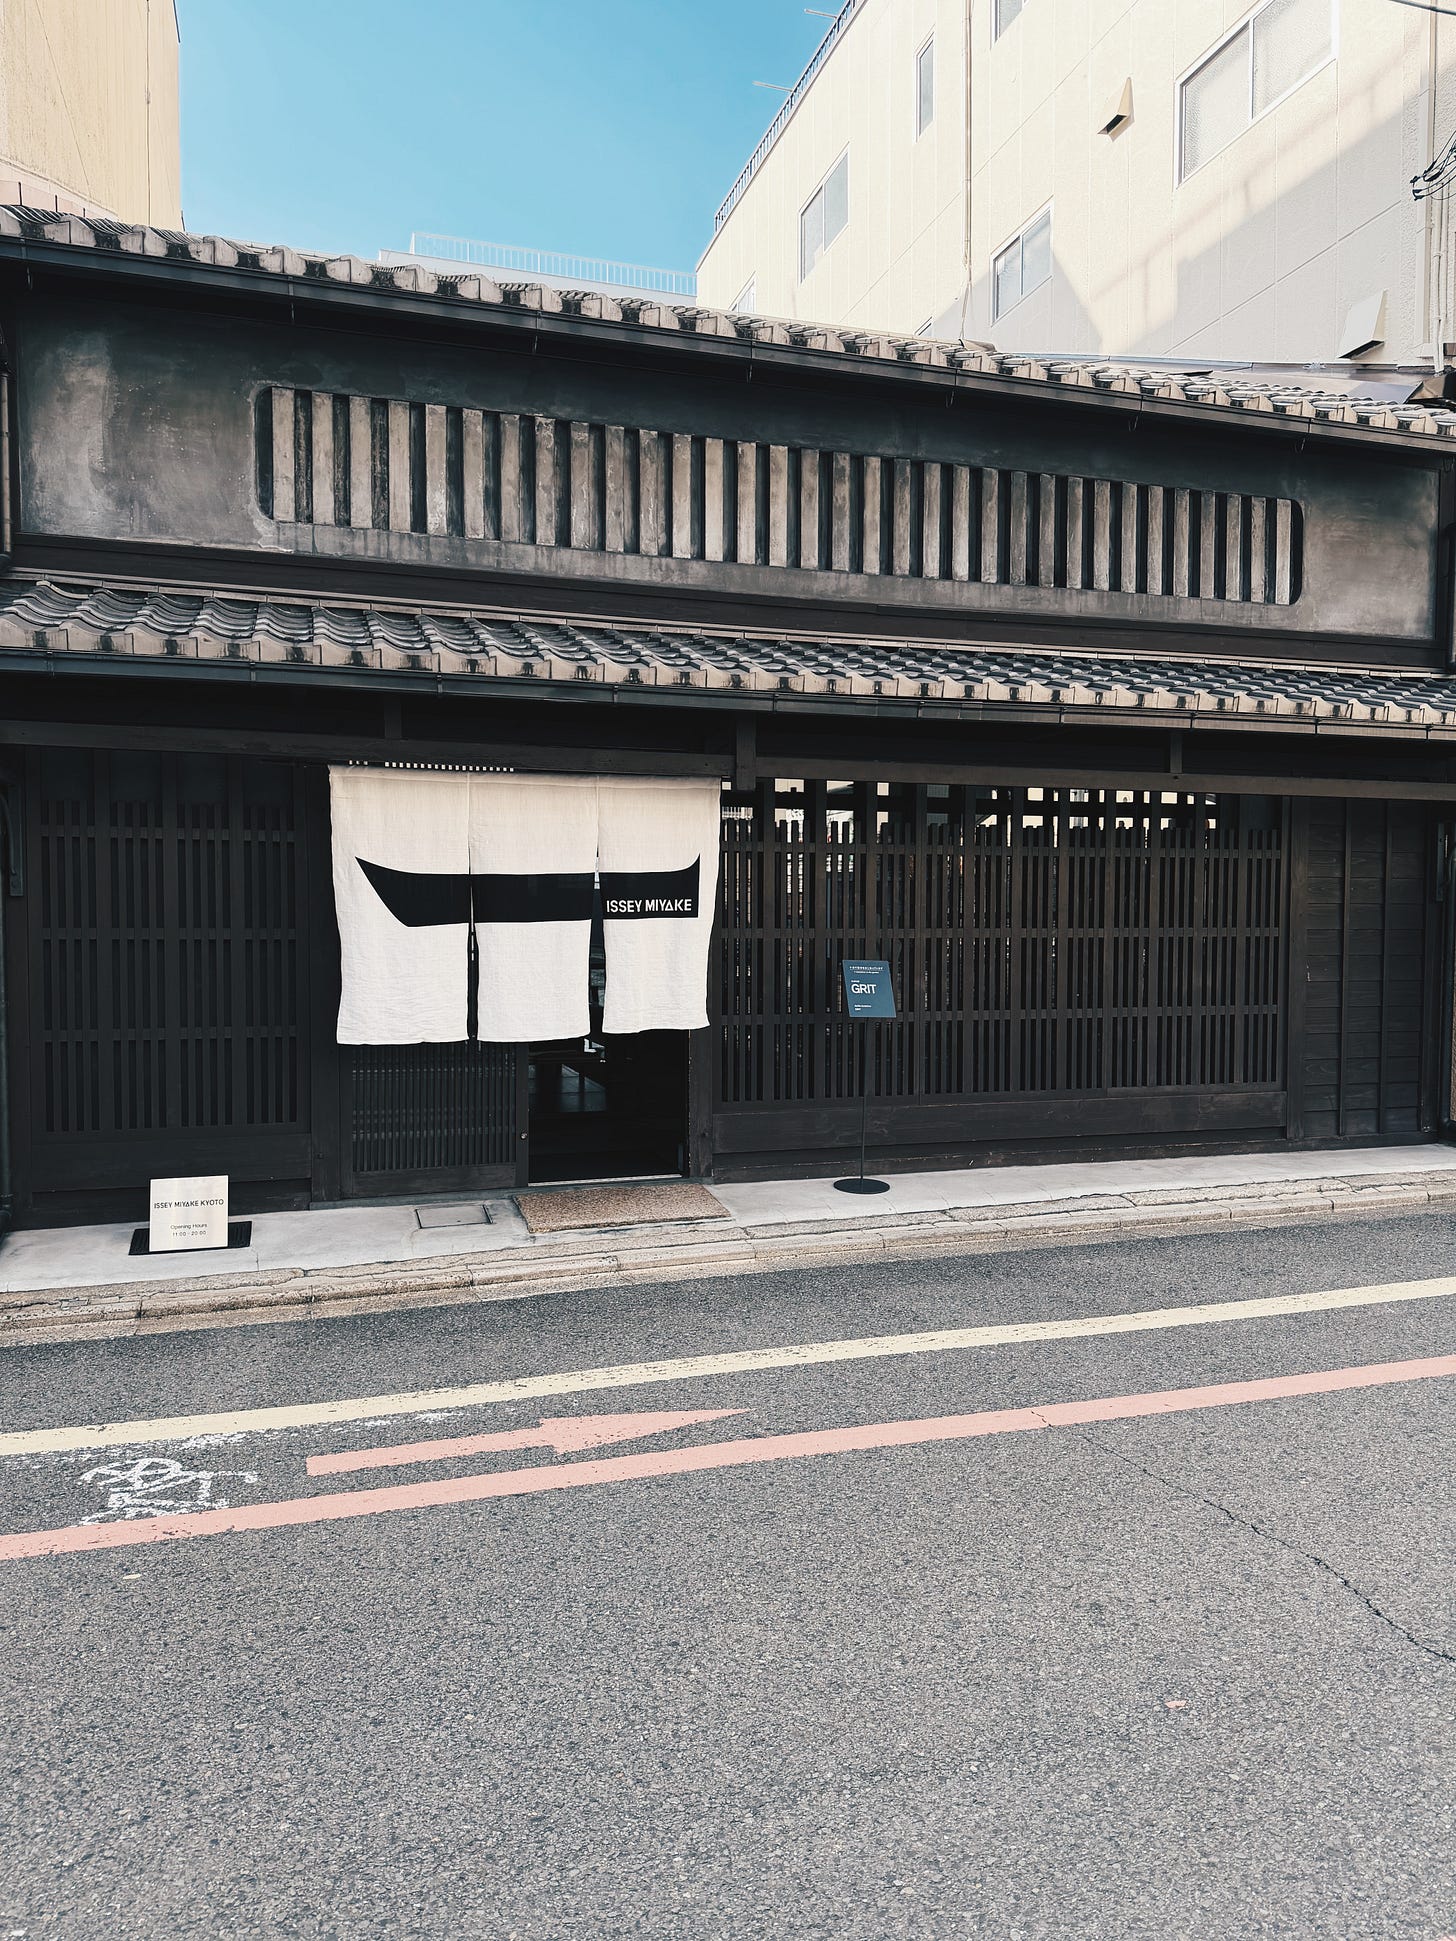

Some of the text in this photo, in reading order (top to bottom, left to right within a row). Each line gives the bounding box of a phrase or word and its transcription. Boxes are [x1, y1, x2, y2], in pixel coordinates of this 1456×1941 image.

[606, 898, 692, 913] ISSEY MIYAKE
[851, 983, 877, 994] GRIT
[154, 1198, 224, 1209] ISSEY MIYAKE KYOTO
